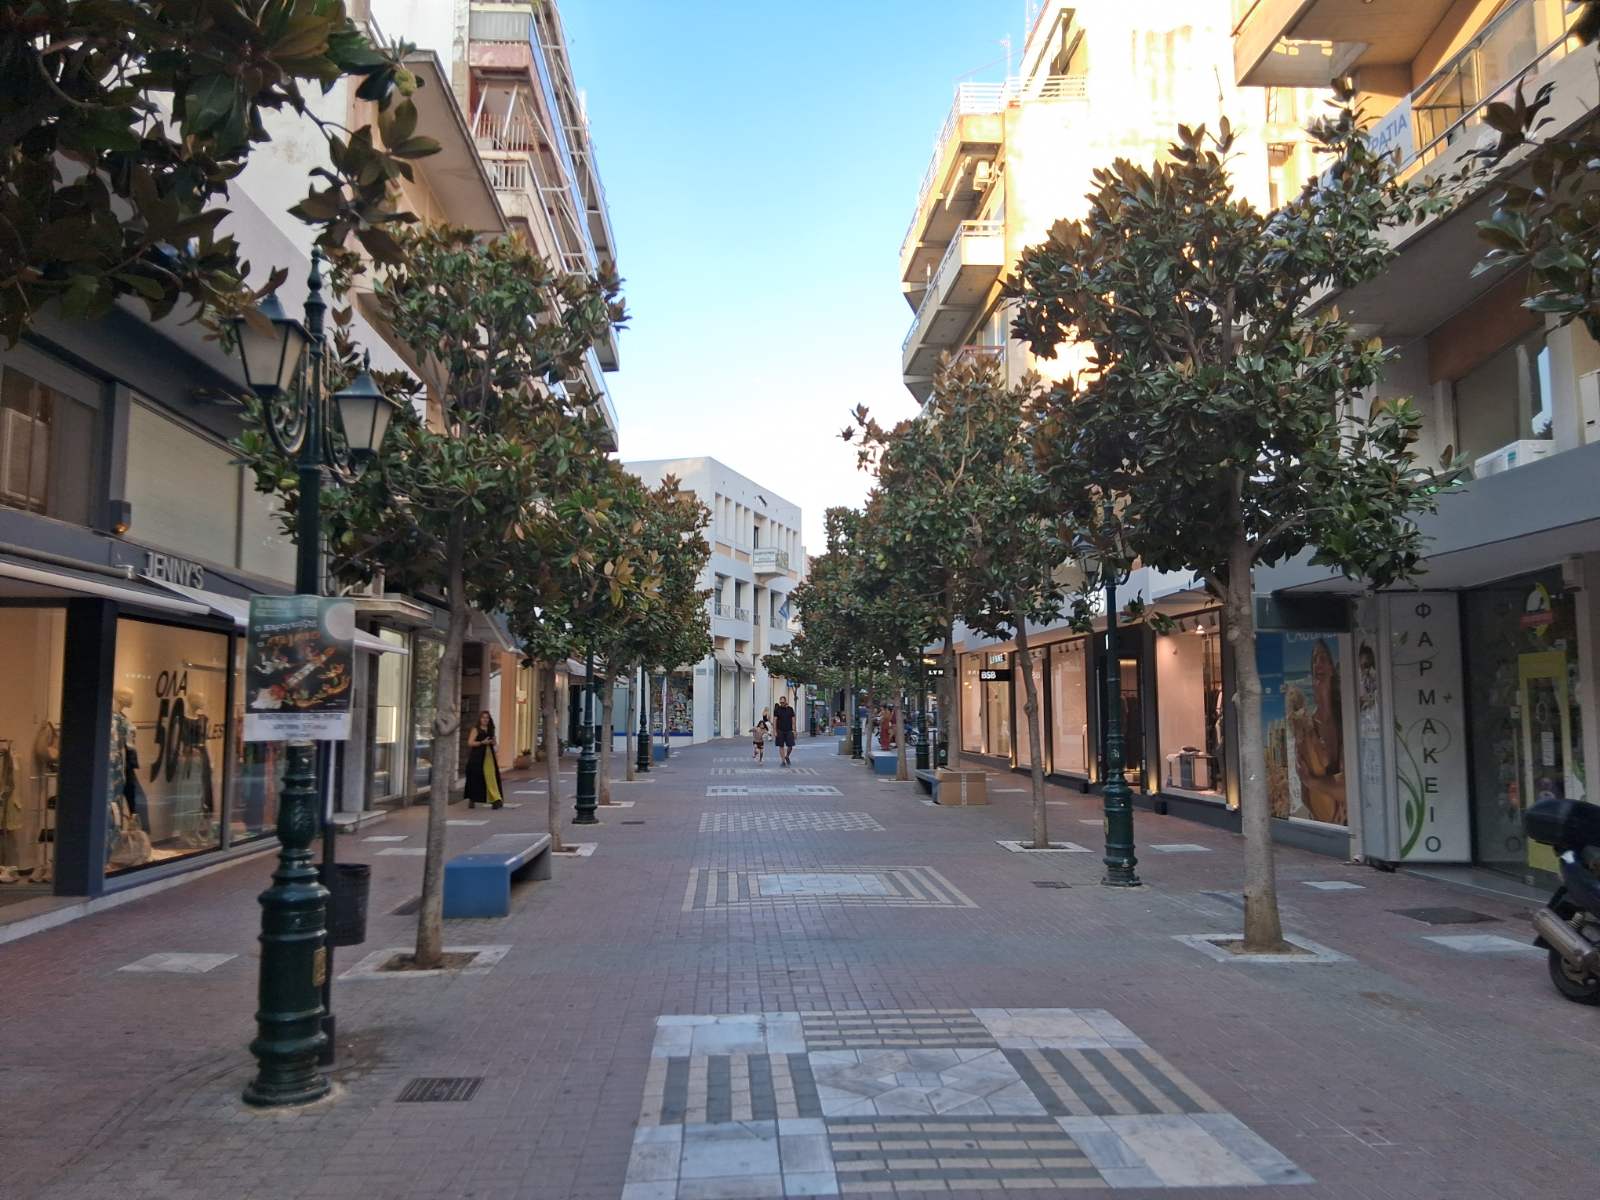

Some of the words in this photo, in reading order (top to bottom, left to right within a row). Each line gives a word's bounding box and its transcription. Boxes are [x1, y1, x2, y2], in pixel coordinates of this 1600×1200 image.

[144, 551, 205, 590] JENNY'S
[981, 671, 996, 679] BSB
[1415, 602, 1442, 853] ΦΑΡΜΑΚΕΙΟ
